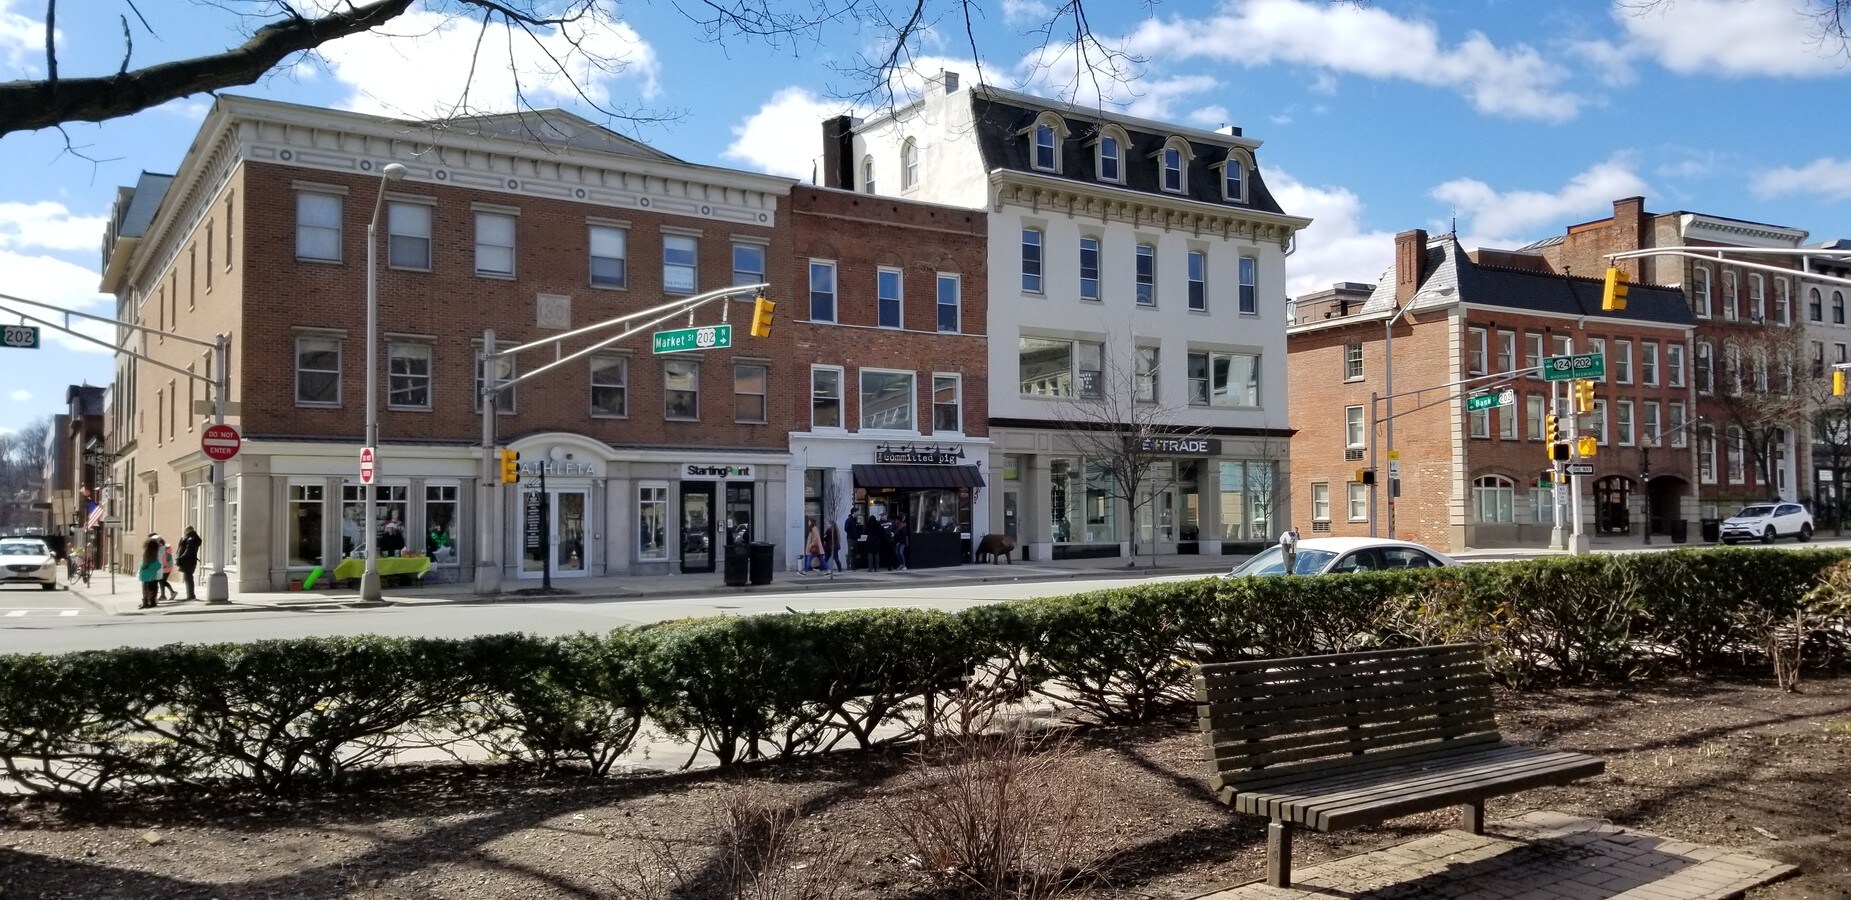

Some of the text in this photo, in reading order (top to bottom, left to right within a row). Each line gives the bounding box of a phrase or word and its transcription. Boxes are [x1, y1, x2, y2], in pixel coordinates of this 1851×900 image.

[6, 330, 32, 343] 202
[655, 331, 715, 348] Market St 202
[1555, 360, 1570, 369] 124
[1575, 358, 1590, 368] 202
[1475, 398, 1492, 407] Bank
[1499, 393, 1512, 403] 202
[220, 431, 233, 439] NOT
[938, 453, 956, 464] pig
[521, 463, 595, 475] ATHLETA
[687, 465, 750, 478] StartingPoint
